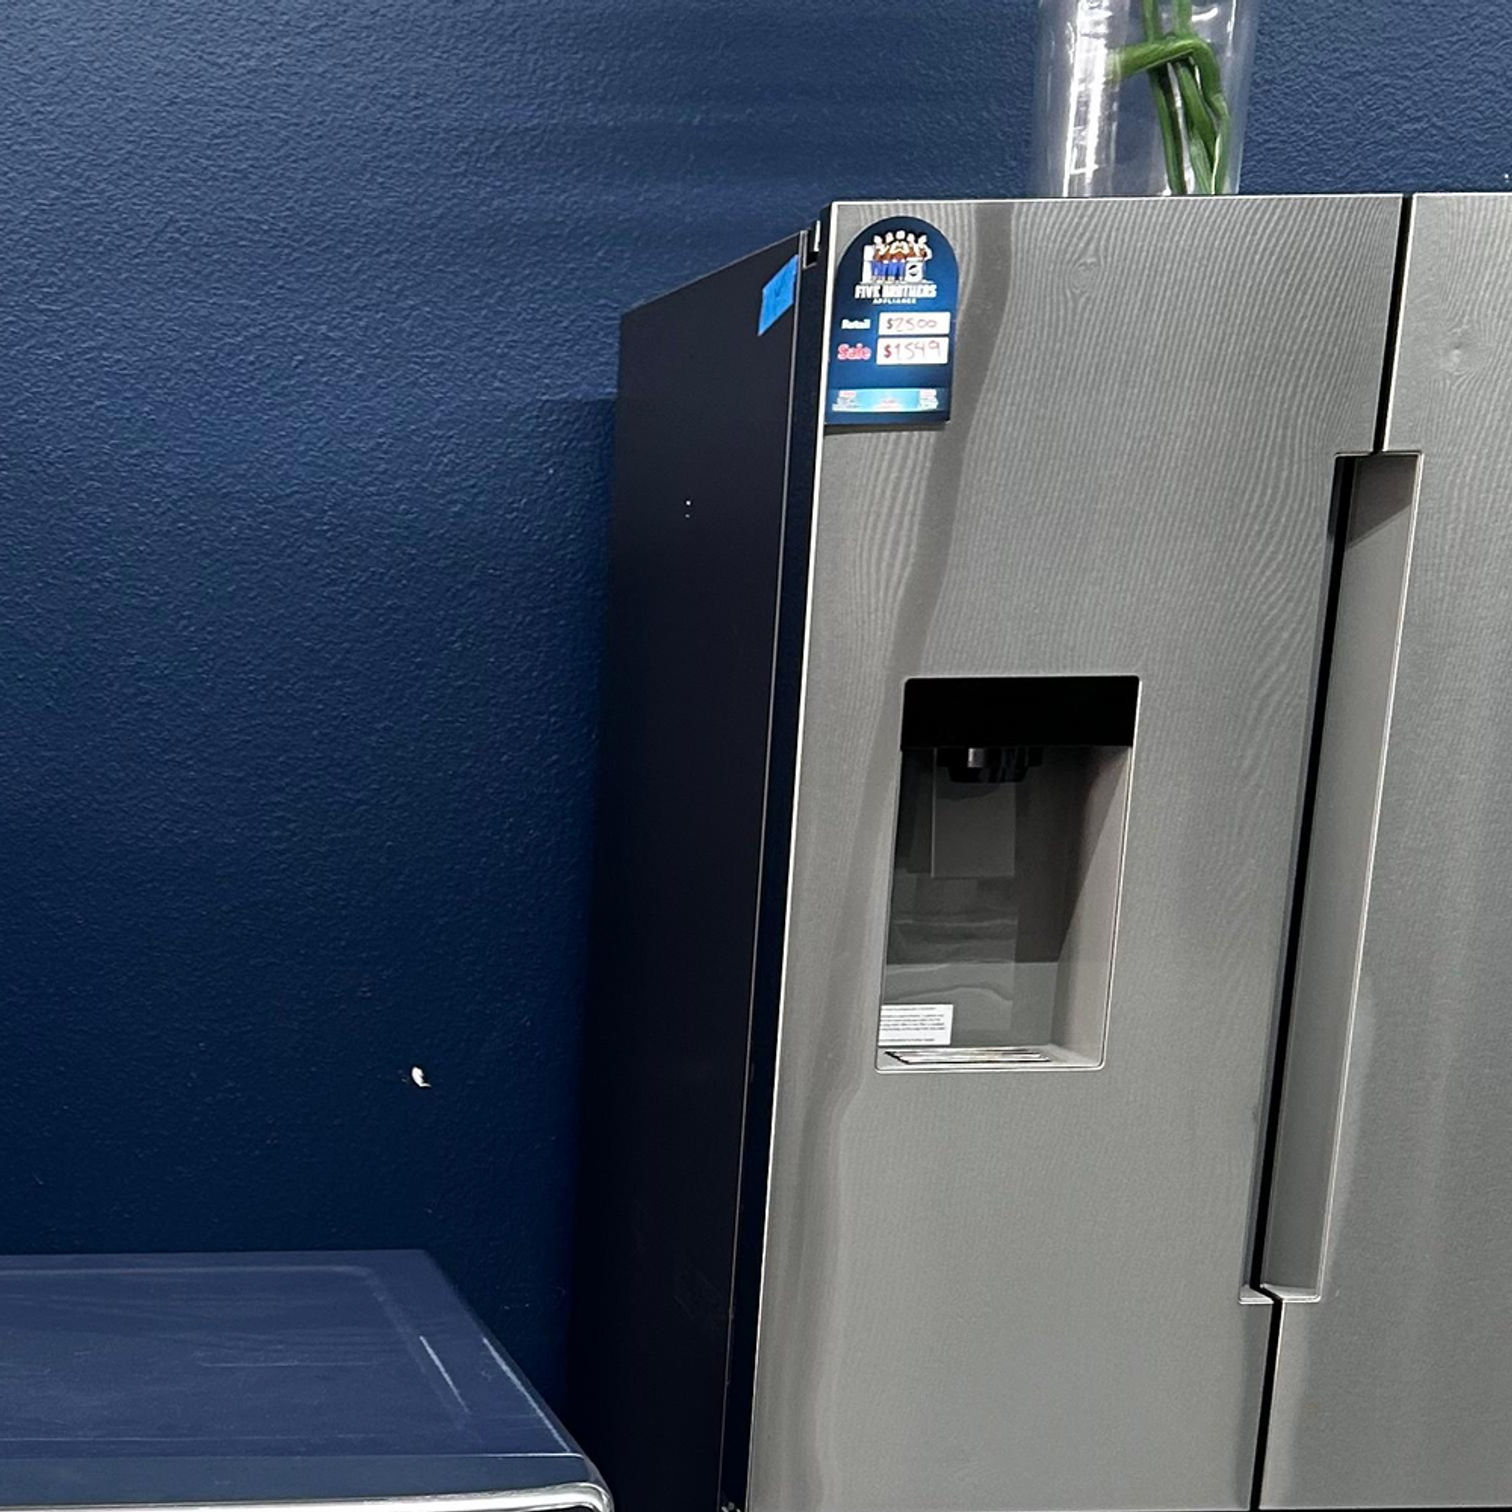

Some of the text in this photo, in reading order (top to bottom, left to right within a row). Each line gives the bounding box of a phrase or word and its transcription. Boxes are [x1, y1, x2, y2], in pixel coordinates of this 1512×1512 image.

[855, 284, 937, 298] FIVE BROTHERS
[841, 318, 938, 331] Retail $2500
[838, 343, 872, 360] Sale
